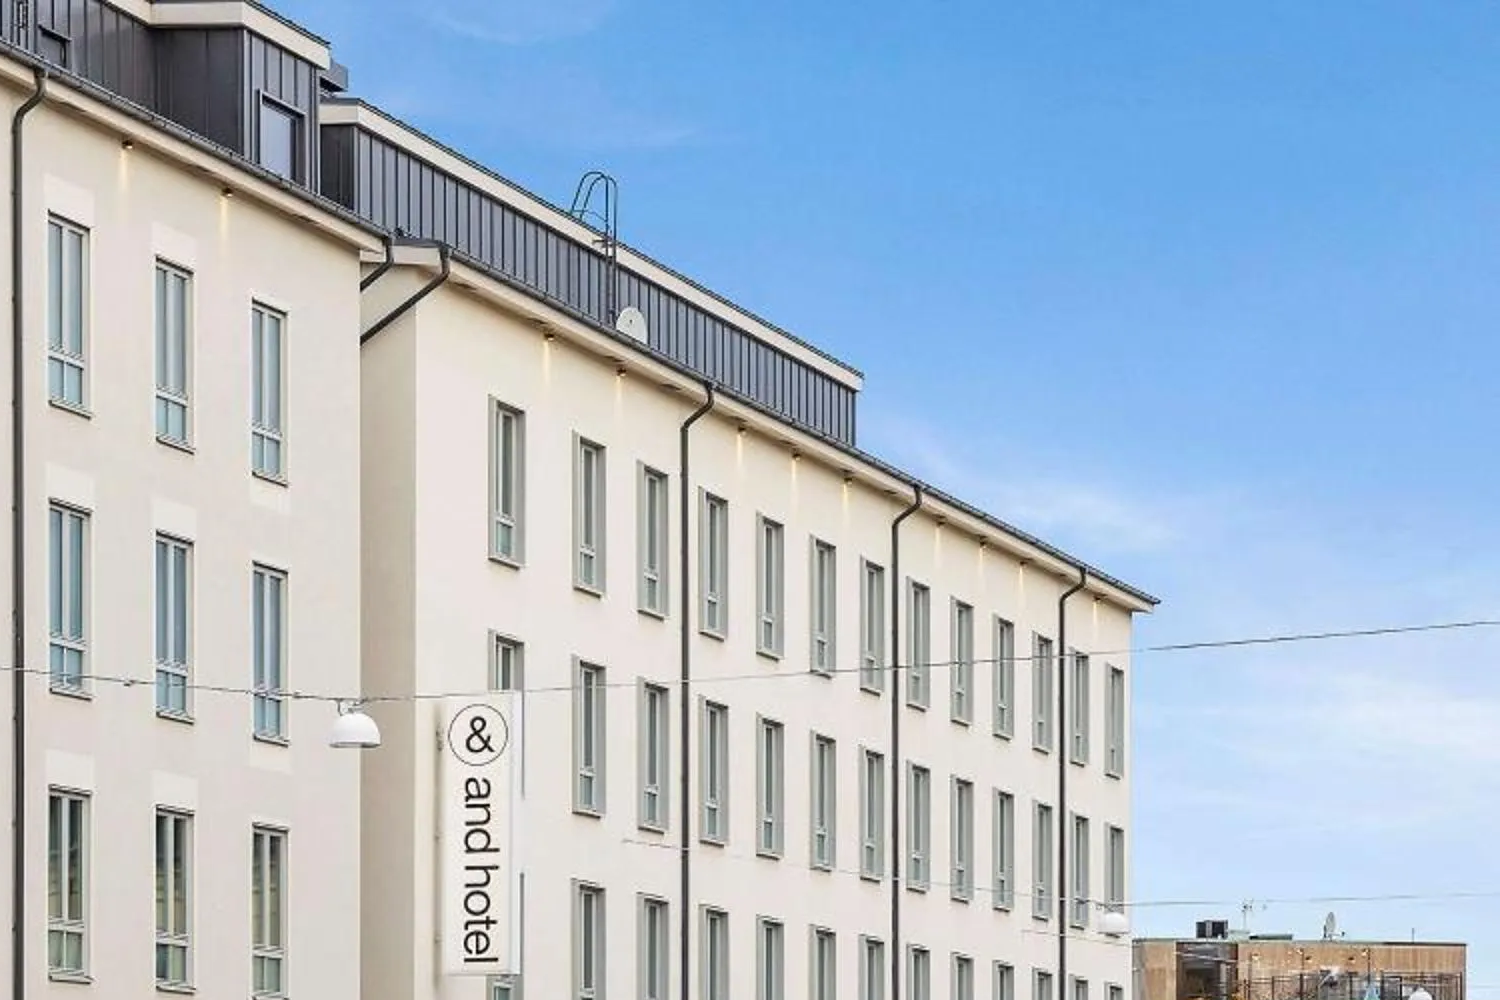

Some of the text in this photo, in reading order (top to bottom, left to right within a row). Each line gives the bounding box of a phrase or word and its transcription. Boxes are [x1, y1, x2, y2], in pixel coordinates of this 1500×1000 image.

[465, 715, 495, 753] &
[463, 776, 500, 963] and hotel
